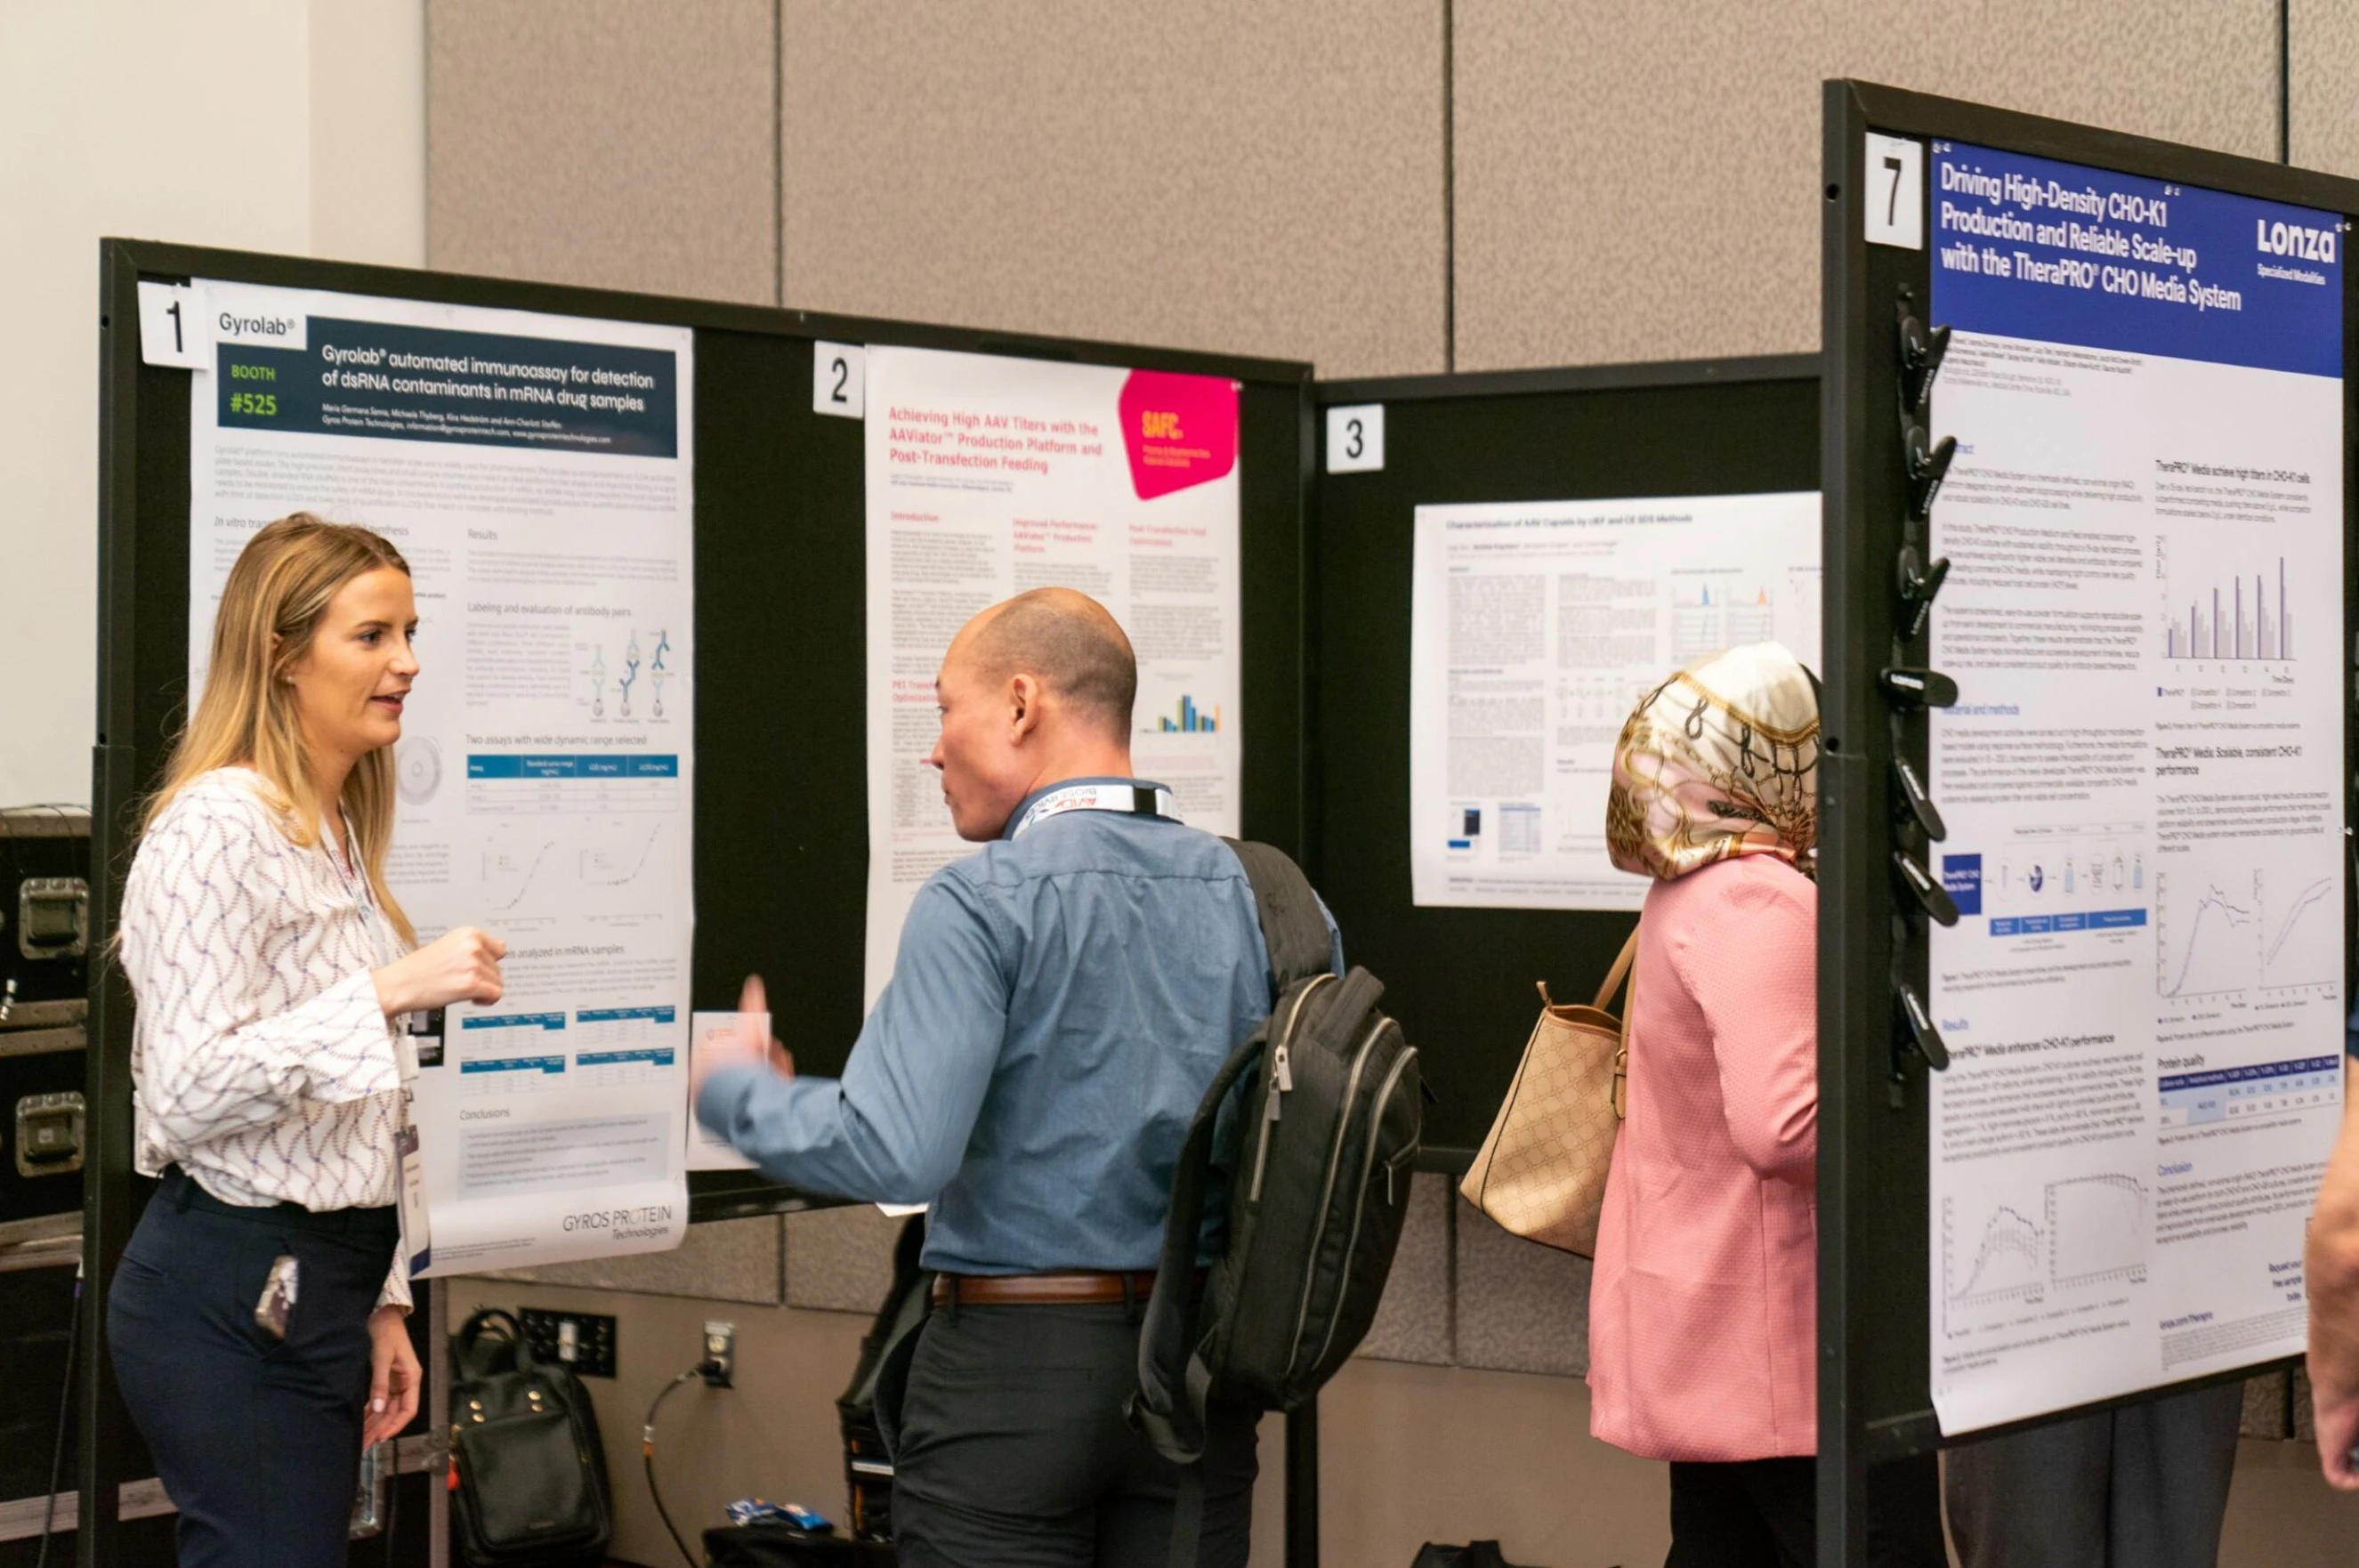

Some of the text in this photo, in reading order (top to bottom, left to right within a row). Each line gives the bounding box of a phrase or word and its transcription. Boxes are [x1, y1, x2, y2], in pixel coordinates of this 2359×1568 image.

[1884, 157, 1902, 227] 7
[1941, 162, 2167, 228] Driving High-Density CHO-K1
[1941, 201, 2197, 273] Production and Reliable Scale-up
[2257, 219, 2336, 264] Lonza
[1941, 241, 1979, 269] with
[1982, 247, 2011, 277] the
[2102, 265, 2138, 295] CHO
[2141, 271, 2185, 303] Media
[2188, 279, 2242, 311] System
[166, 301, 183, 353] 1
[219, 311, 295, 336] Gyrolab®
[230, 364, 276, 381] BOOTH
[389, 353, 468, 375] automated
[471, 357, 568, 385] immunoassay
[570, 366, 590, 384] for
[591, 368, 655, 390] detection
[831, 357, 848, 404] 2
[230, 392, 278, 416] #525
[322, 368, 645, 414] of dsRNA contaminants in mRNA drug samples
[889, 407, 1099, 436] Achieving High AAV Titers with the
[957, 433, 1023, 451] Production
[1027, 437, 1078, 454] Platform
[1080, 440, 1103, 456] and
[1345, 417, 1364, 460] 3
[889, 448, 1049, 475] Post-Transfection Feeding
[890, 510, 941, 523] Introduction
[467, 528, 498, 542] Results
[467, 602, 503, 617] Labeling
[505, 603, 520, 615] and
[521, 603, 562, 616] evaluation
[465, 734, 483, 745] Two
[459, 1108, 510, 1121] Conclusions
[562, 1204, 673, 1233] GYROS PROTEIN
[611, 1224, 669, 1242] Technologies
